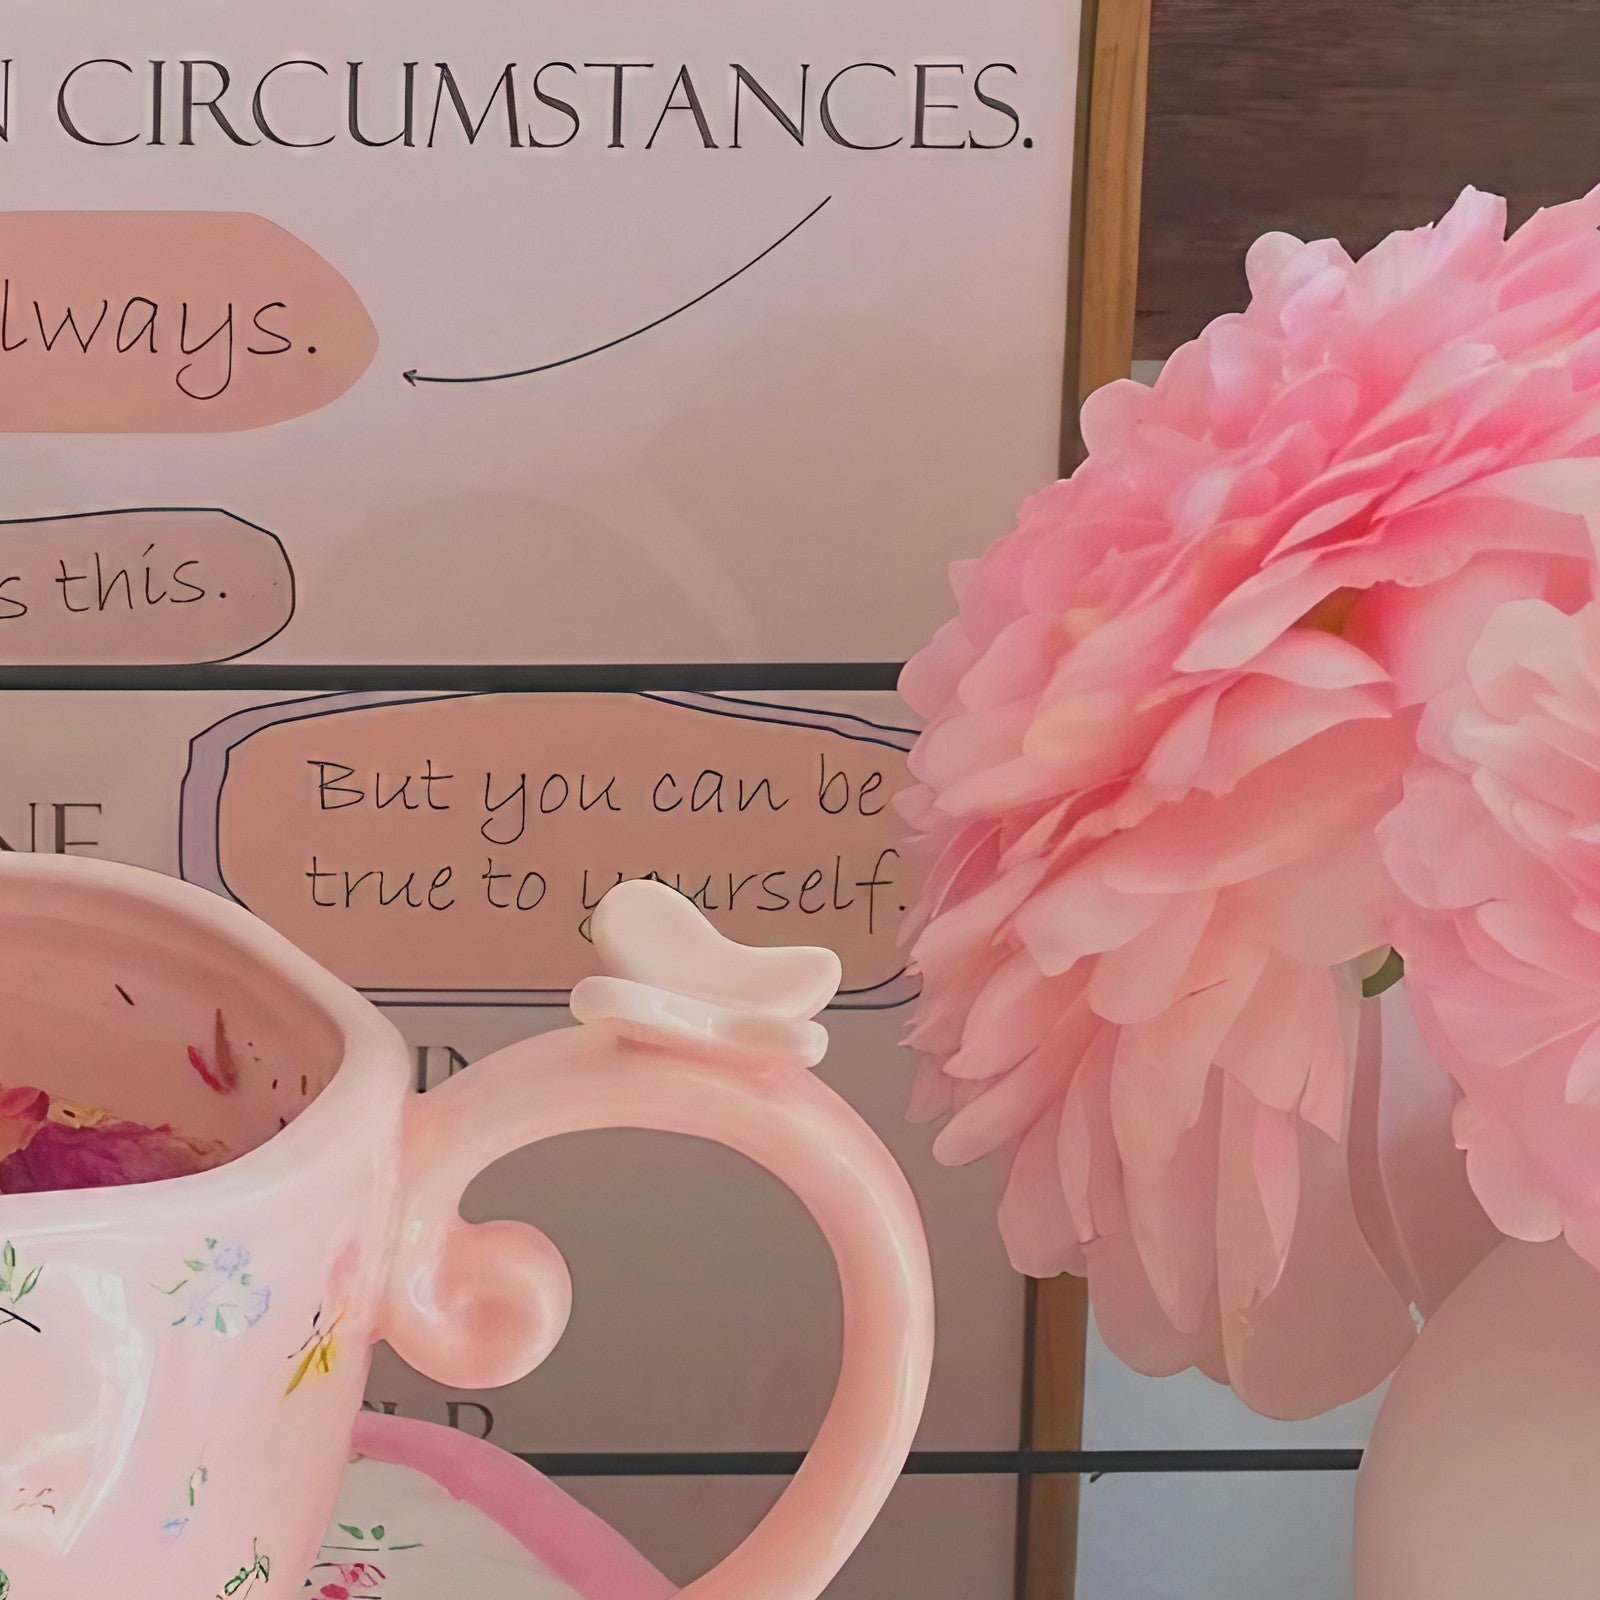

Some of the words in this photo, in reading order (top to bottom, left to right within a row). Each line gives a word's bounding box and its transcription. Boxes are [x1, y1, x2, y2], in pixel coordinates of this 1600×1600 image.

[57, 59, 1033, 150] CIRCUMSTANCES.
[55, 544, 226, 612] this.
[307, 759, 453, 810] But
[481, 772, 621, 845] you
[653, 769, 789, 813] can
[819, 753, 885, 816] be
[306, 856, 454, 911] true
[482, 858, 546, 910] to
